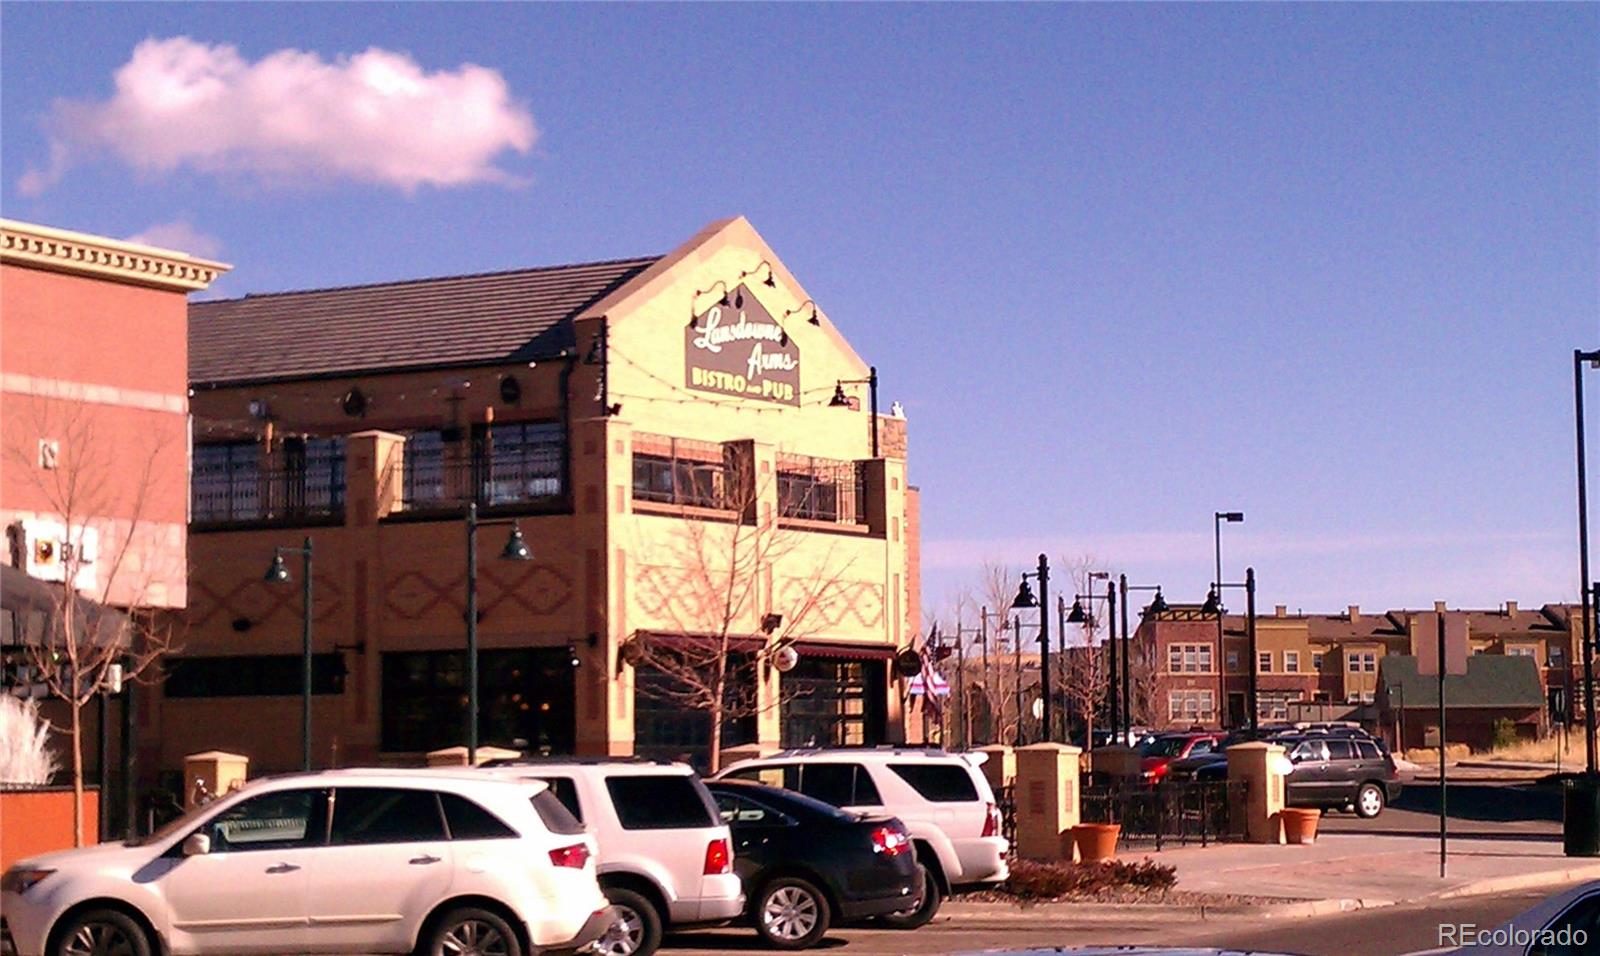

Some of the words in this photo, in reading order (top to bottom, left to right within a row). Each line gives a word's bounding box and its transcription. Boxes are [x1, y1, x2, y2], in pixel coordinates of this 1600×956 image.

[693, 307, 782, 353] Lansdowne
[747, 342, 798, 380] Arms
[692, 367, 746, 392] BISTRO
[762, 379, 793, 400] PUB
